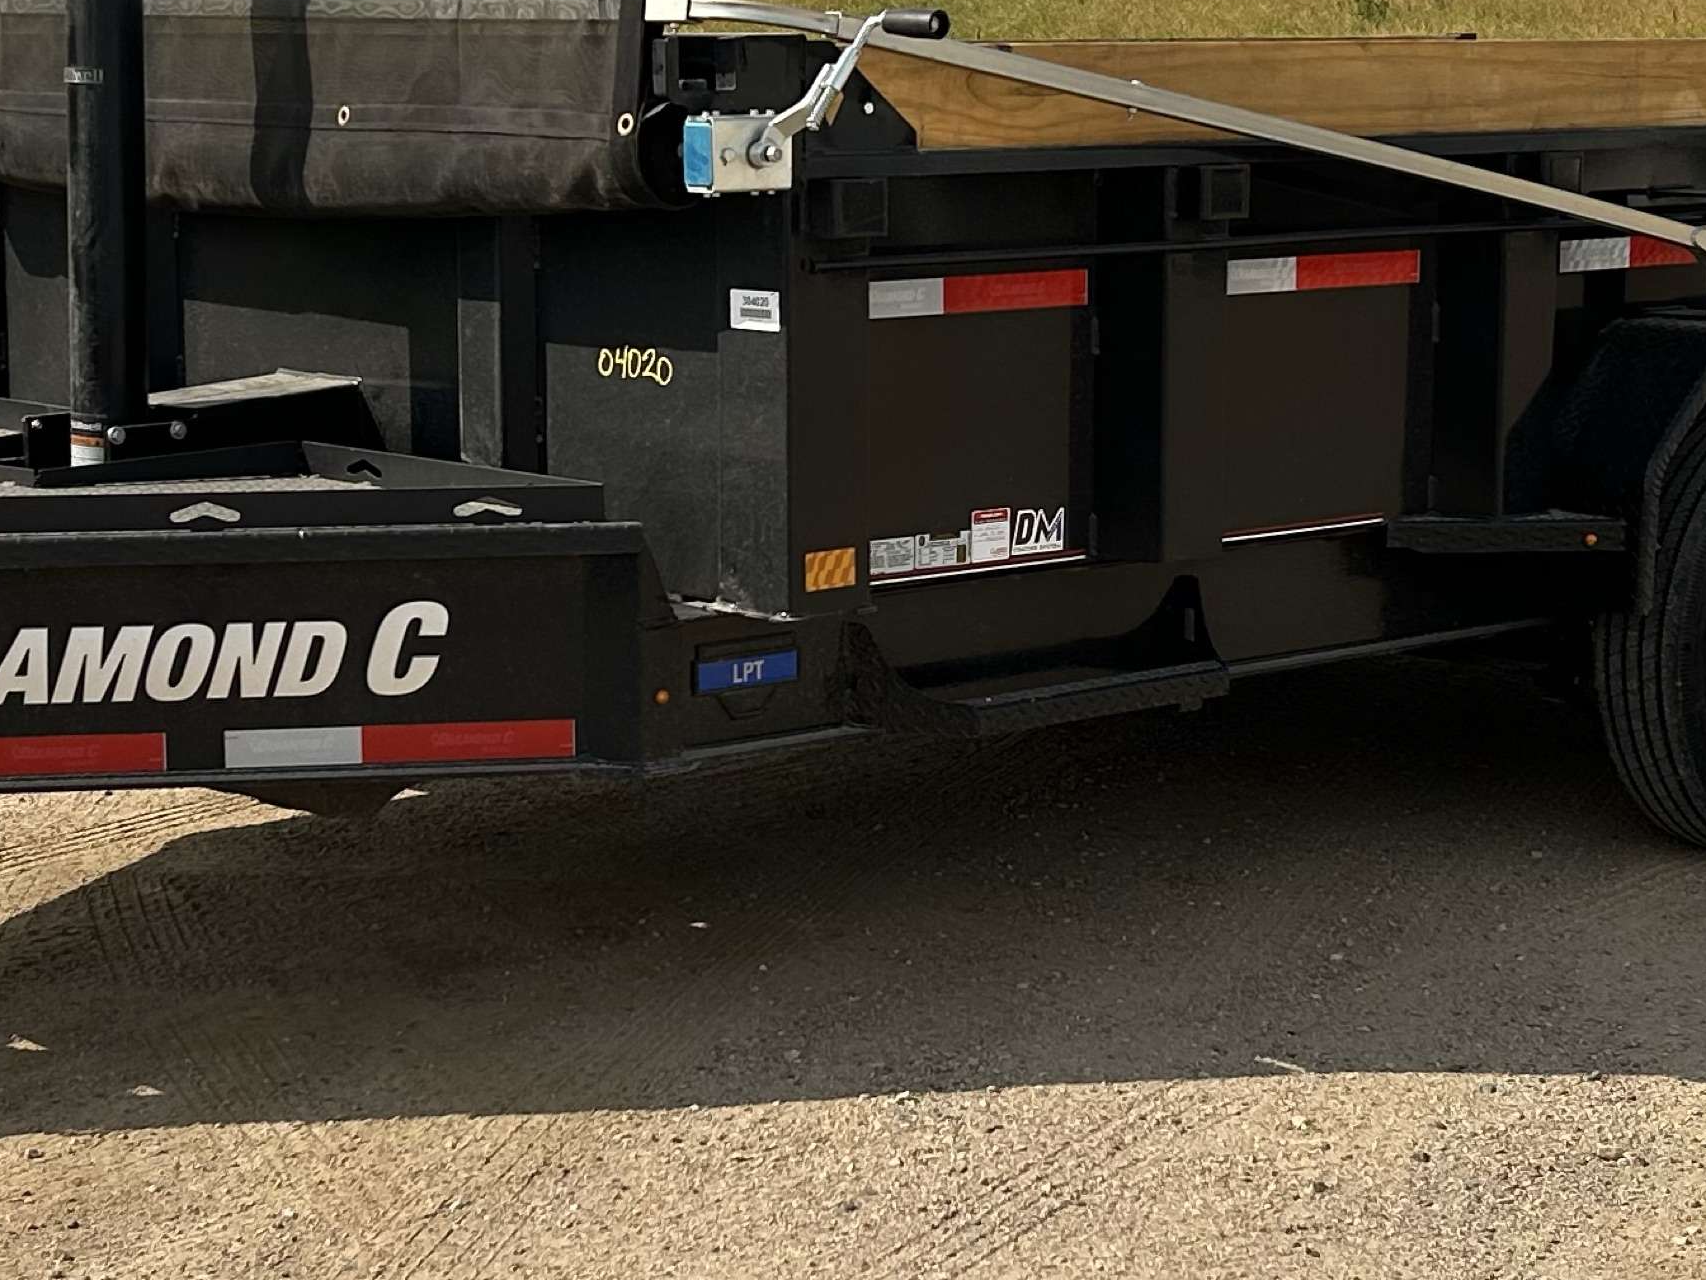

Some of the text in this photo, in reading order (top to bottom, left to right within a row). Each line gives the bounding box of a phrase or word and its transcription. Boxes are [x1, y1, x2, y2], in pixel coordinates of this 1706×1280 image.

[597, 344, 673, 386] 04020
[1013, 508, 1064, 546] DM
[366, 600, 449, 697] C
[732, 659, 765, 684] LPT
